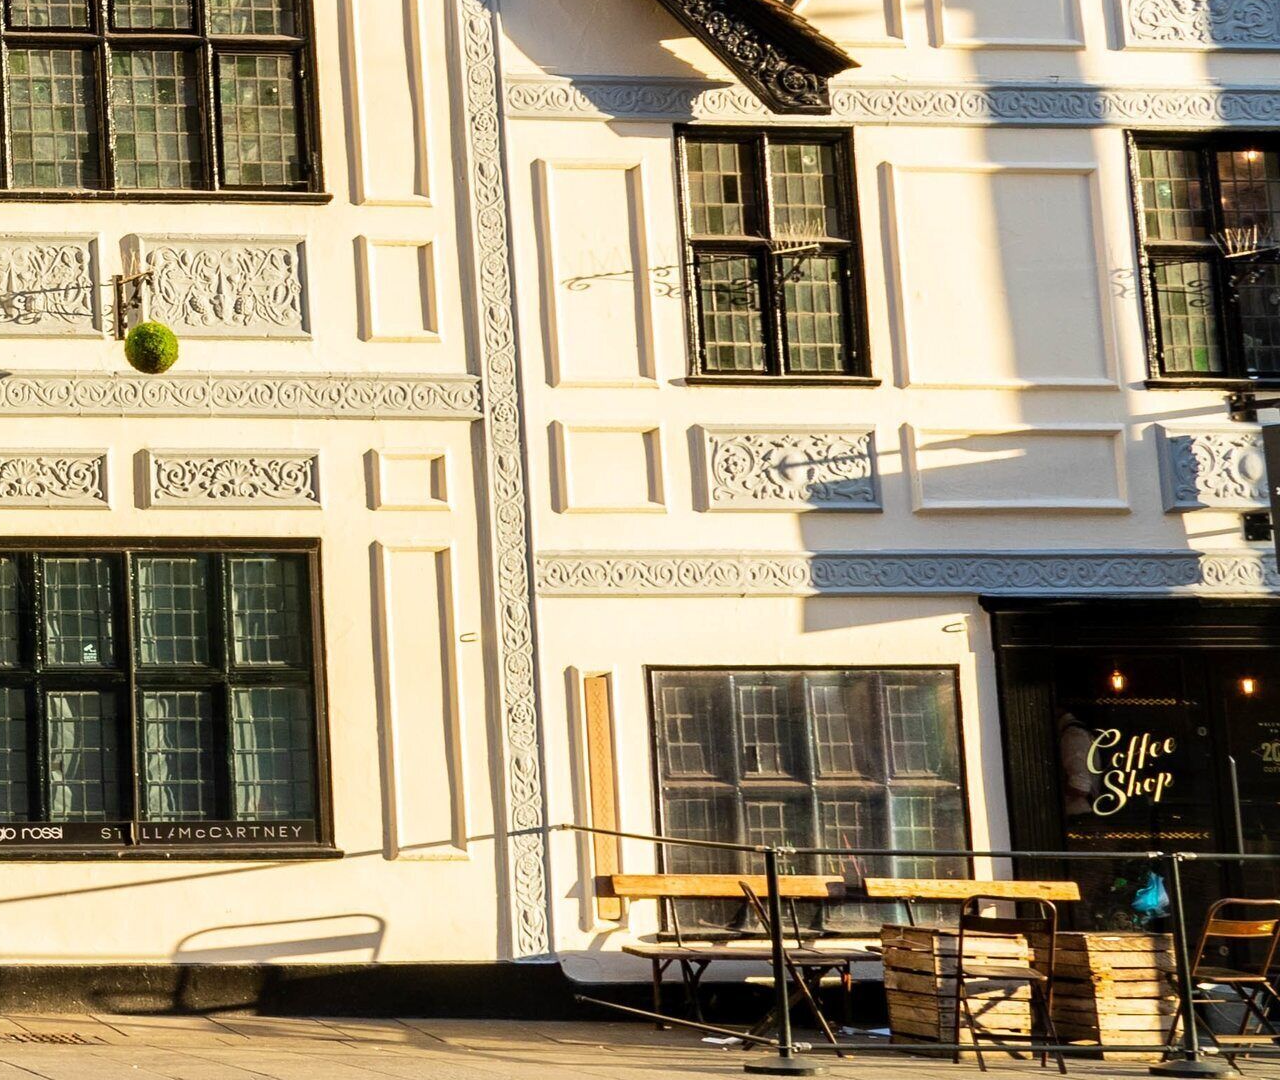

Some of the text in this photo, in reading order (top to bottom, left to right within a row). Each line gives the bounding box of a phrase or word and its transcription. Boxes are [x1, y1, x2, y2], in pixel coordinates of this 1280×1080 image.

[1086, 728, 1177, 774] Coffee
[1092, 769, 1174, 816] Shop
[21, 826, 63, 840] rossi
